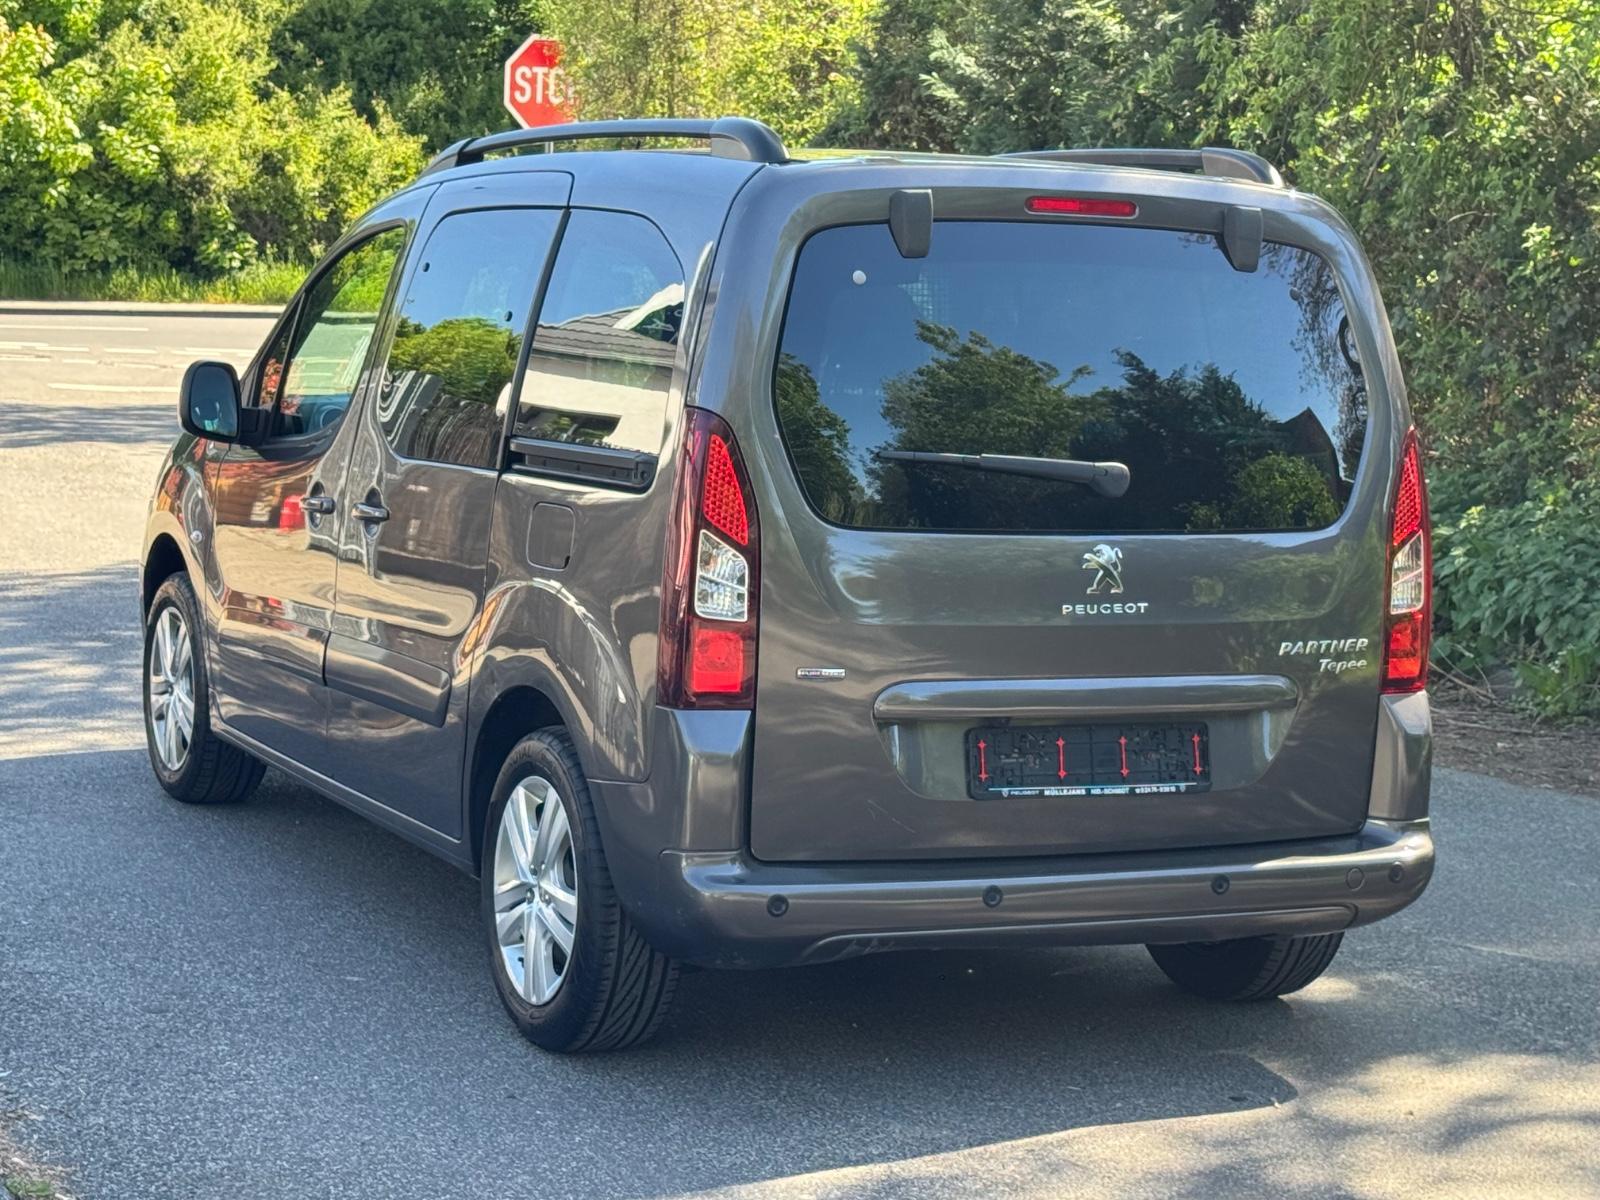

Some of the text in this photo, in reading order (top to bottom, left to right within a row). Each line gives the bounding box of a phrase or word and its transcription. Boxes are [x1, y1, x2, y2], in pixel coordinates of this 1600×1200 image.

[514, 66, 573, 104] STO
[1062, 603, 1149, 615] PEUGEOT
[1278, 638, 1369, 656] PARTNER
[1319, 658, 1368, 675] Tepee
